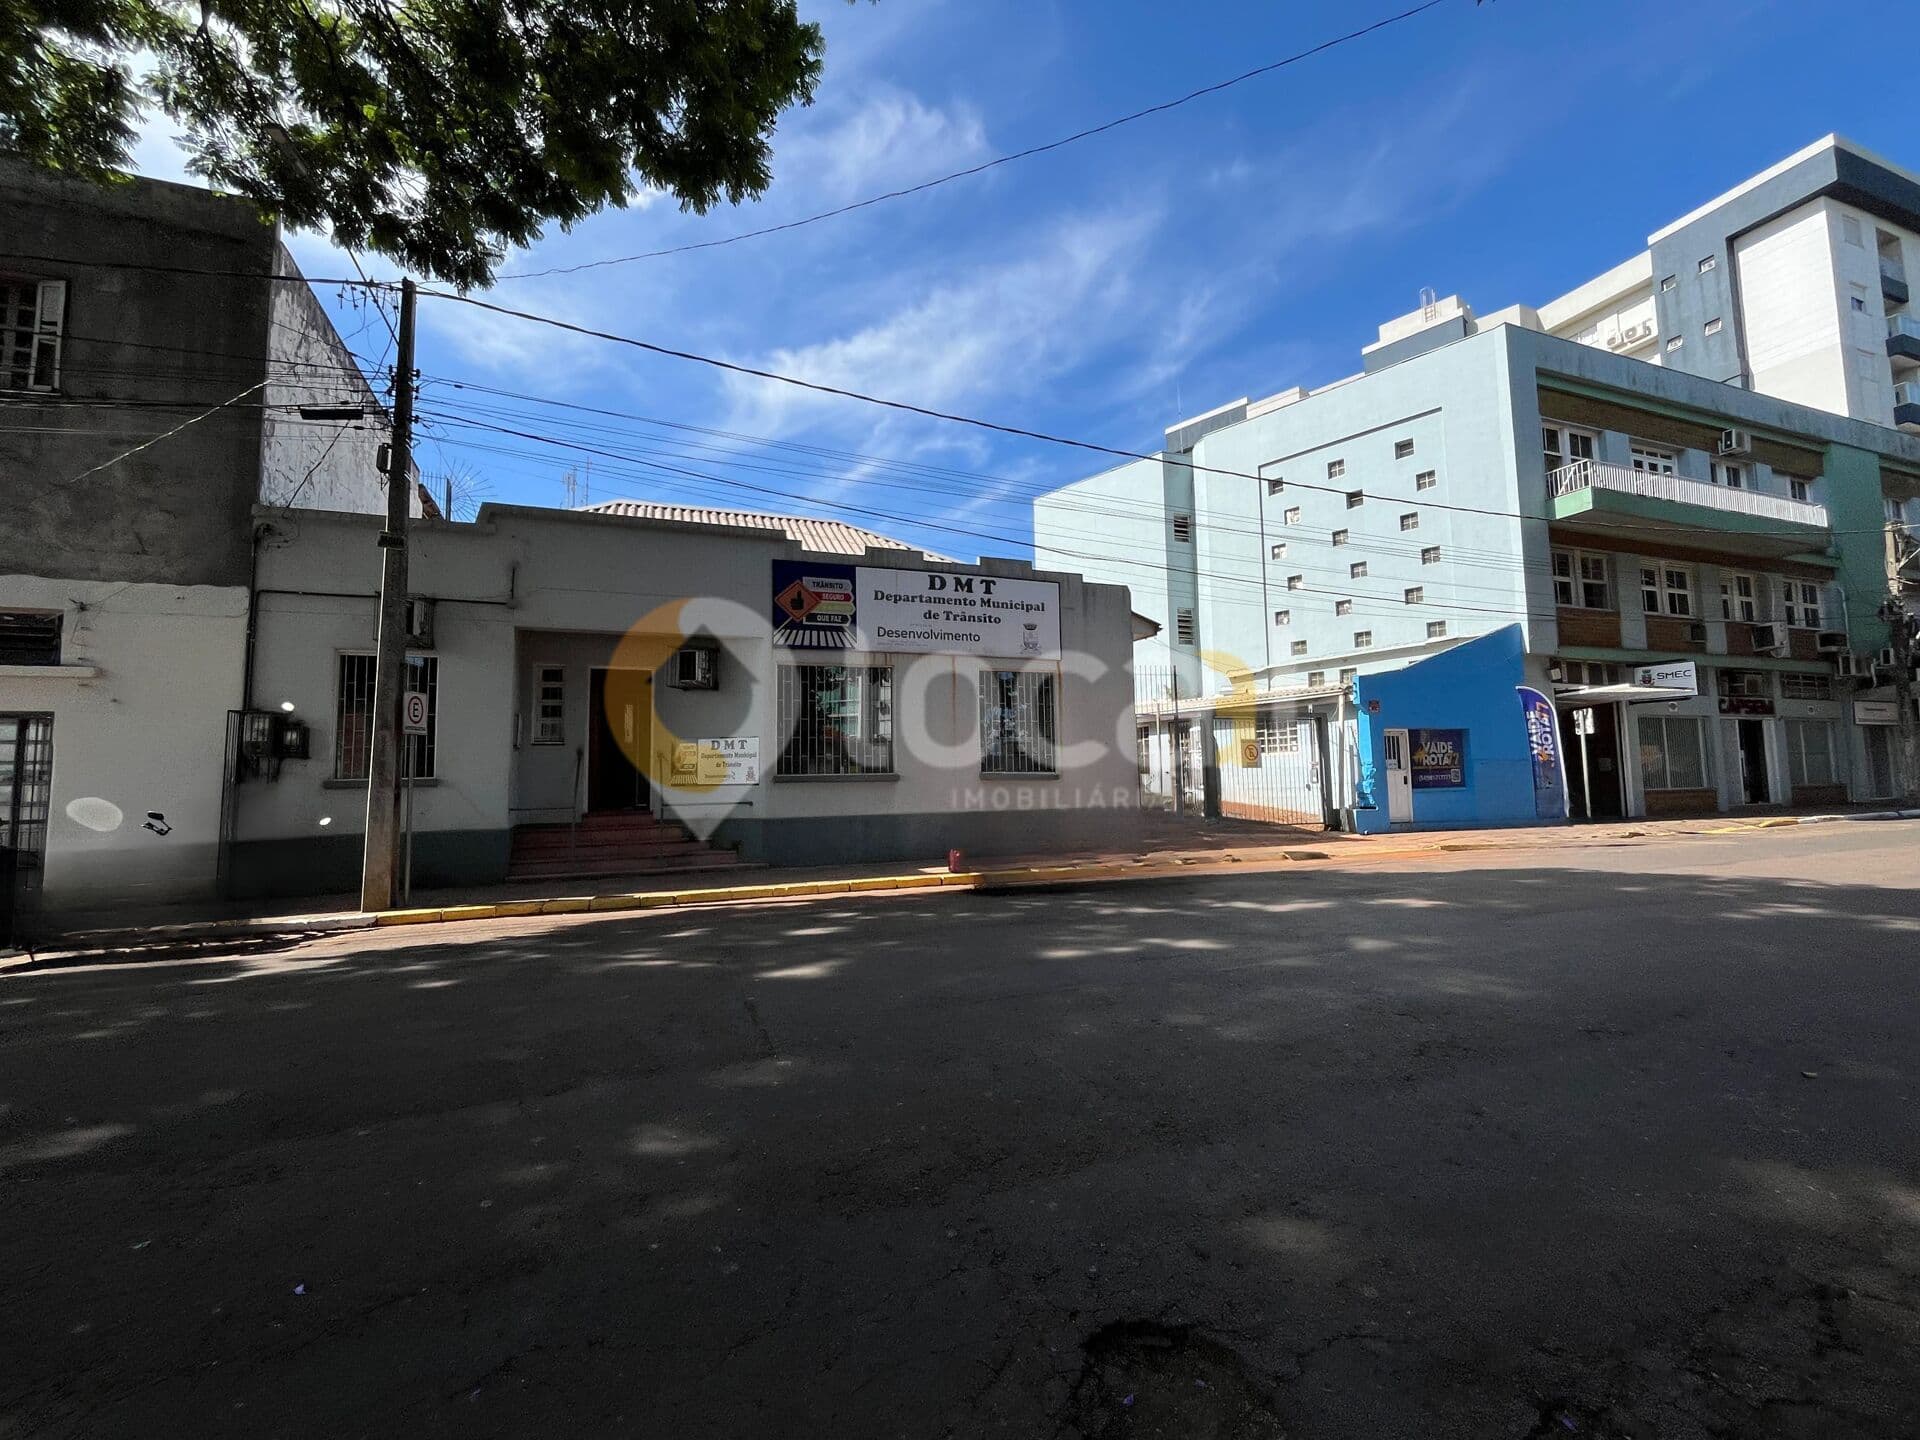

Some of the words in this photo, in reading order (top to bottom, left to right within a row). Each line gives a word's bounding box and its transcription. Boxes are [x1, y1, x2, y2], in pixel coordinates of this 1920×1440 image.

[811, 580, 844, 590] TRÂNSITO
[822, 593, 845, 601] SEGURO
[873, 589, 976, 608] Departamento
[979, 596, 1046, 612] Municipal
[816, 614, 830, 622] QUE
[831, 615, 843, 623] FAZ
[922, 609, 940, 620] de
[942, 610, 1002, 624] Trânsito
[876, 626, 981, 643] Desenvolvimento
[1656, 669, 1692, 680] SMEC
[412, 702, 420, 718] E
